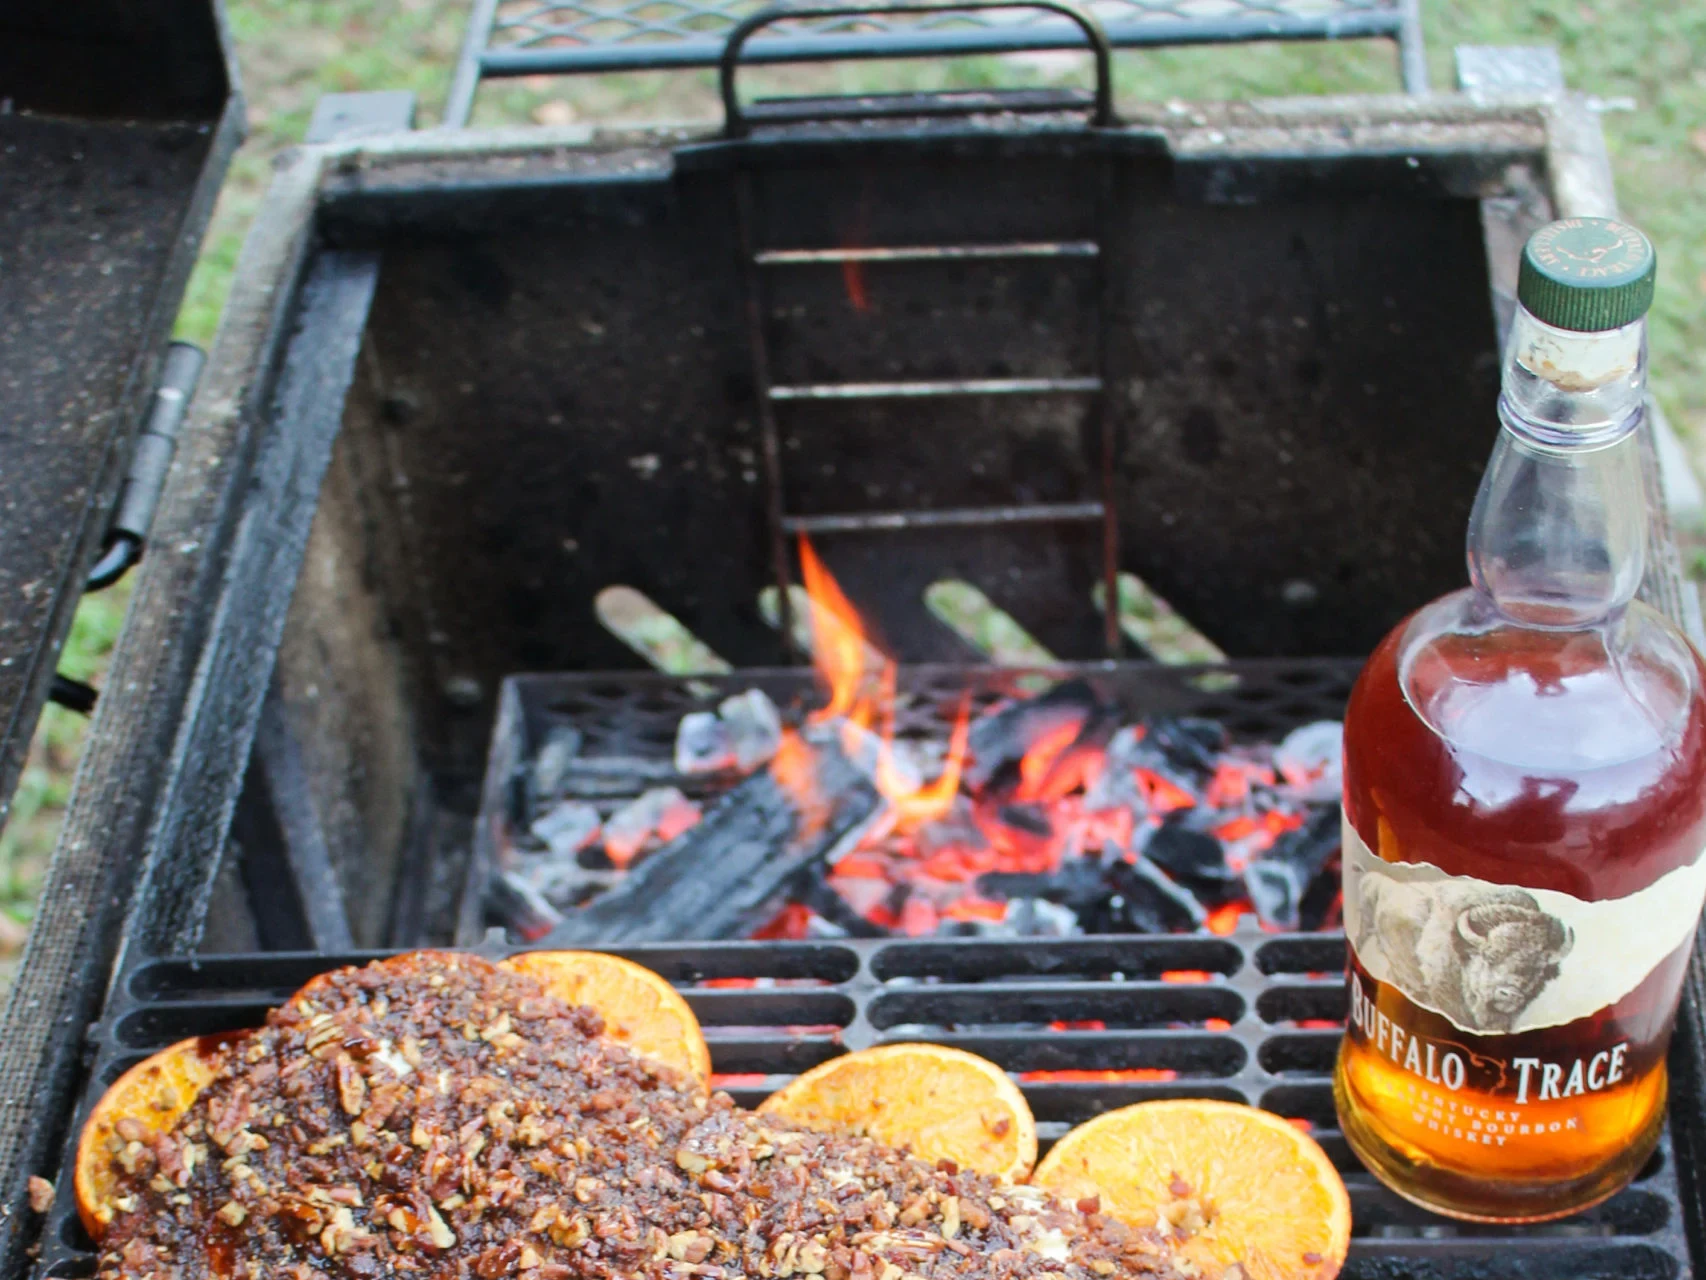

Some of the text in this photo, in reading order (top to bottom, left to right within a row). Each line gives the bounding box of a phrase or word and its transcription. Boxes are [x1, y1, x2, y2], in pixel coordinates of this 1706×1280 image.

[1351, 971, 1630, 1105] BUFFALO TRACE
[1406, 1082, 1521, 1123] KENTUCKY
[1412, 1111, 1506, 1147] WHISKEY
[1471, 1117, 1578, 1135] BOURBON
